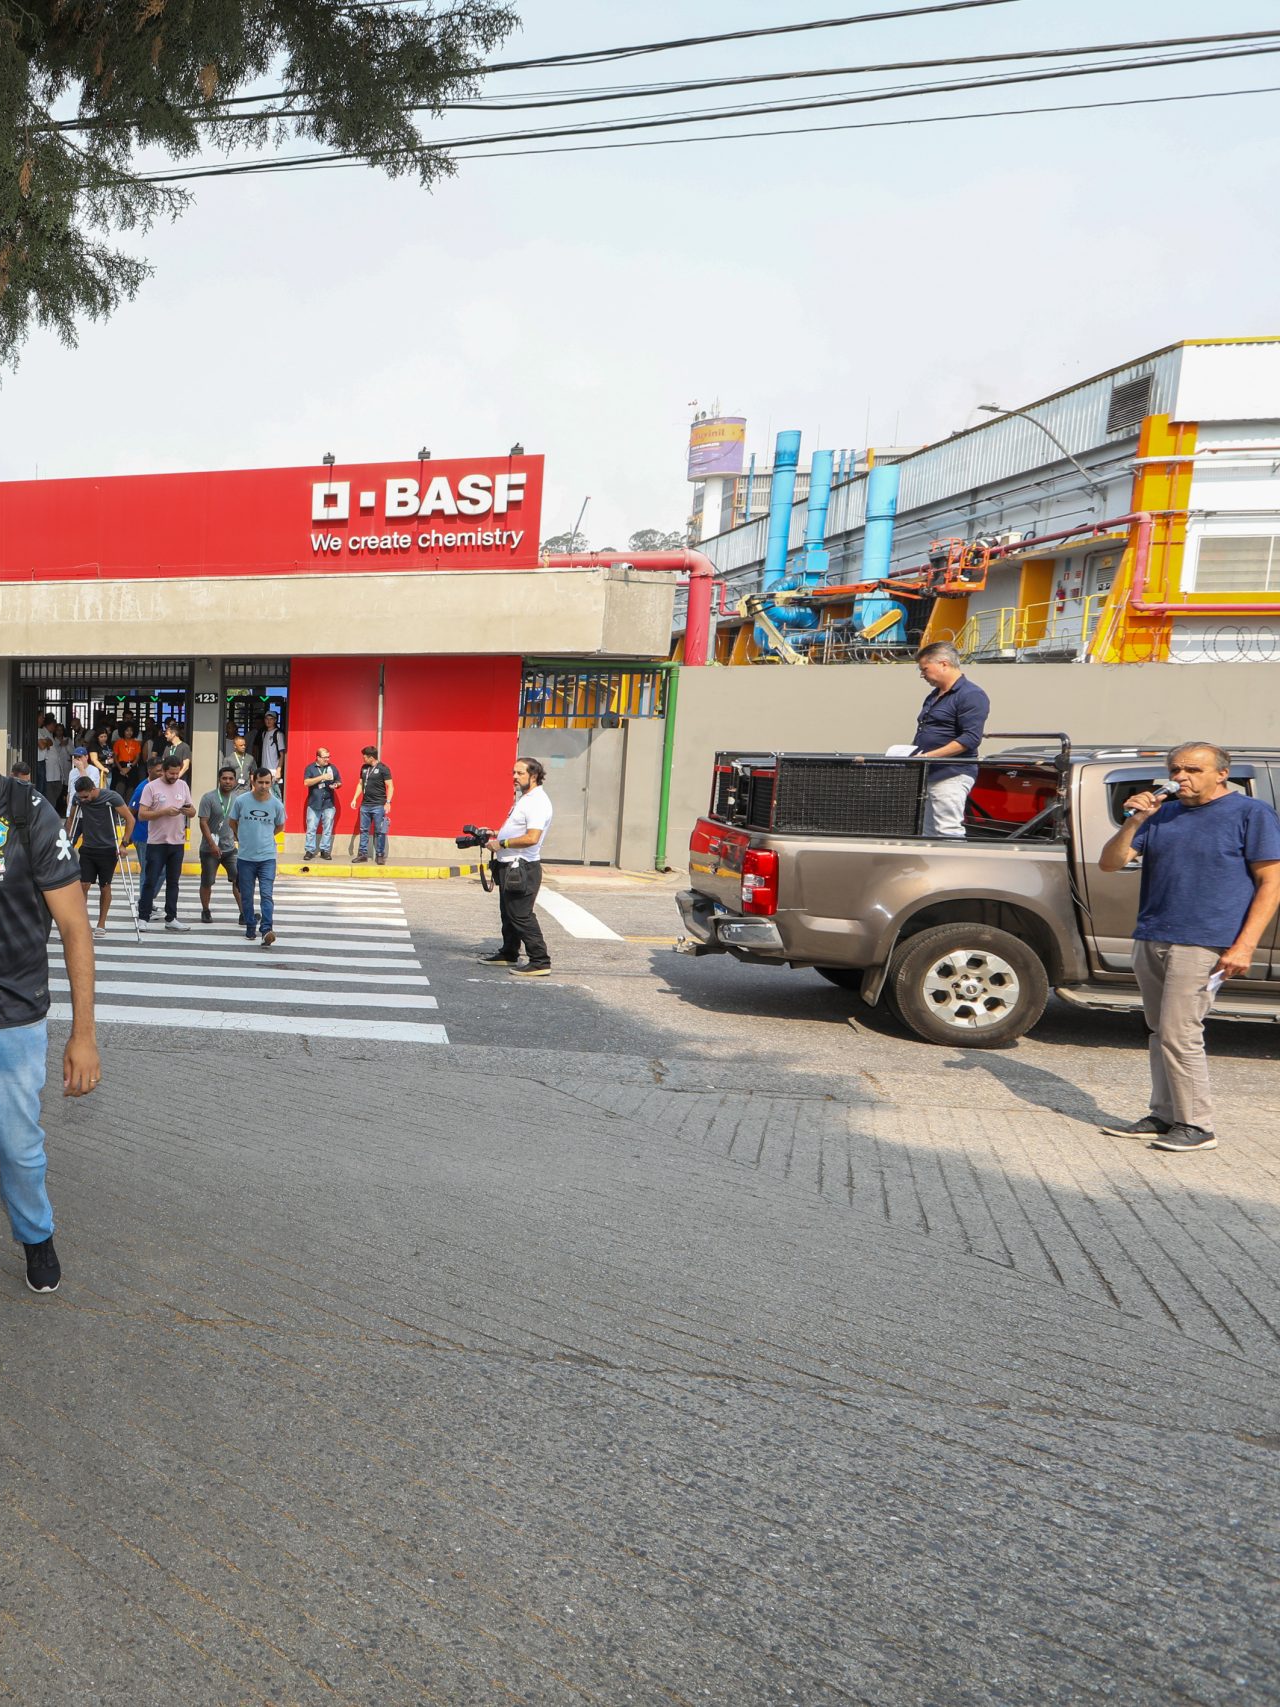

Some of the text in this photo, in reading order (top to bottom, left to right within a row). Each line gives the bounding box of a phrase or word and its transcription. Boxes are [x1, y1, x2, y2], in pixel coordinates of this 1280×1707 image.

[384, 472, 527, 518] BASF
[310, 526, 525, 552] We create chemistry
[197, 693, 216, 703] 123
